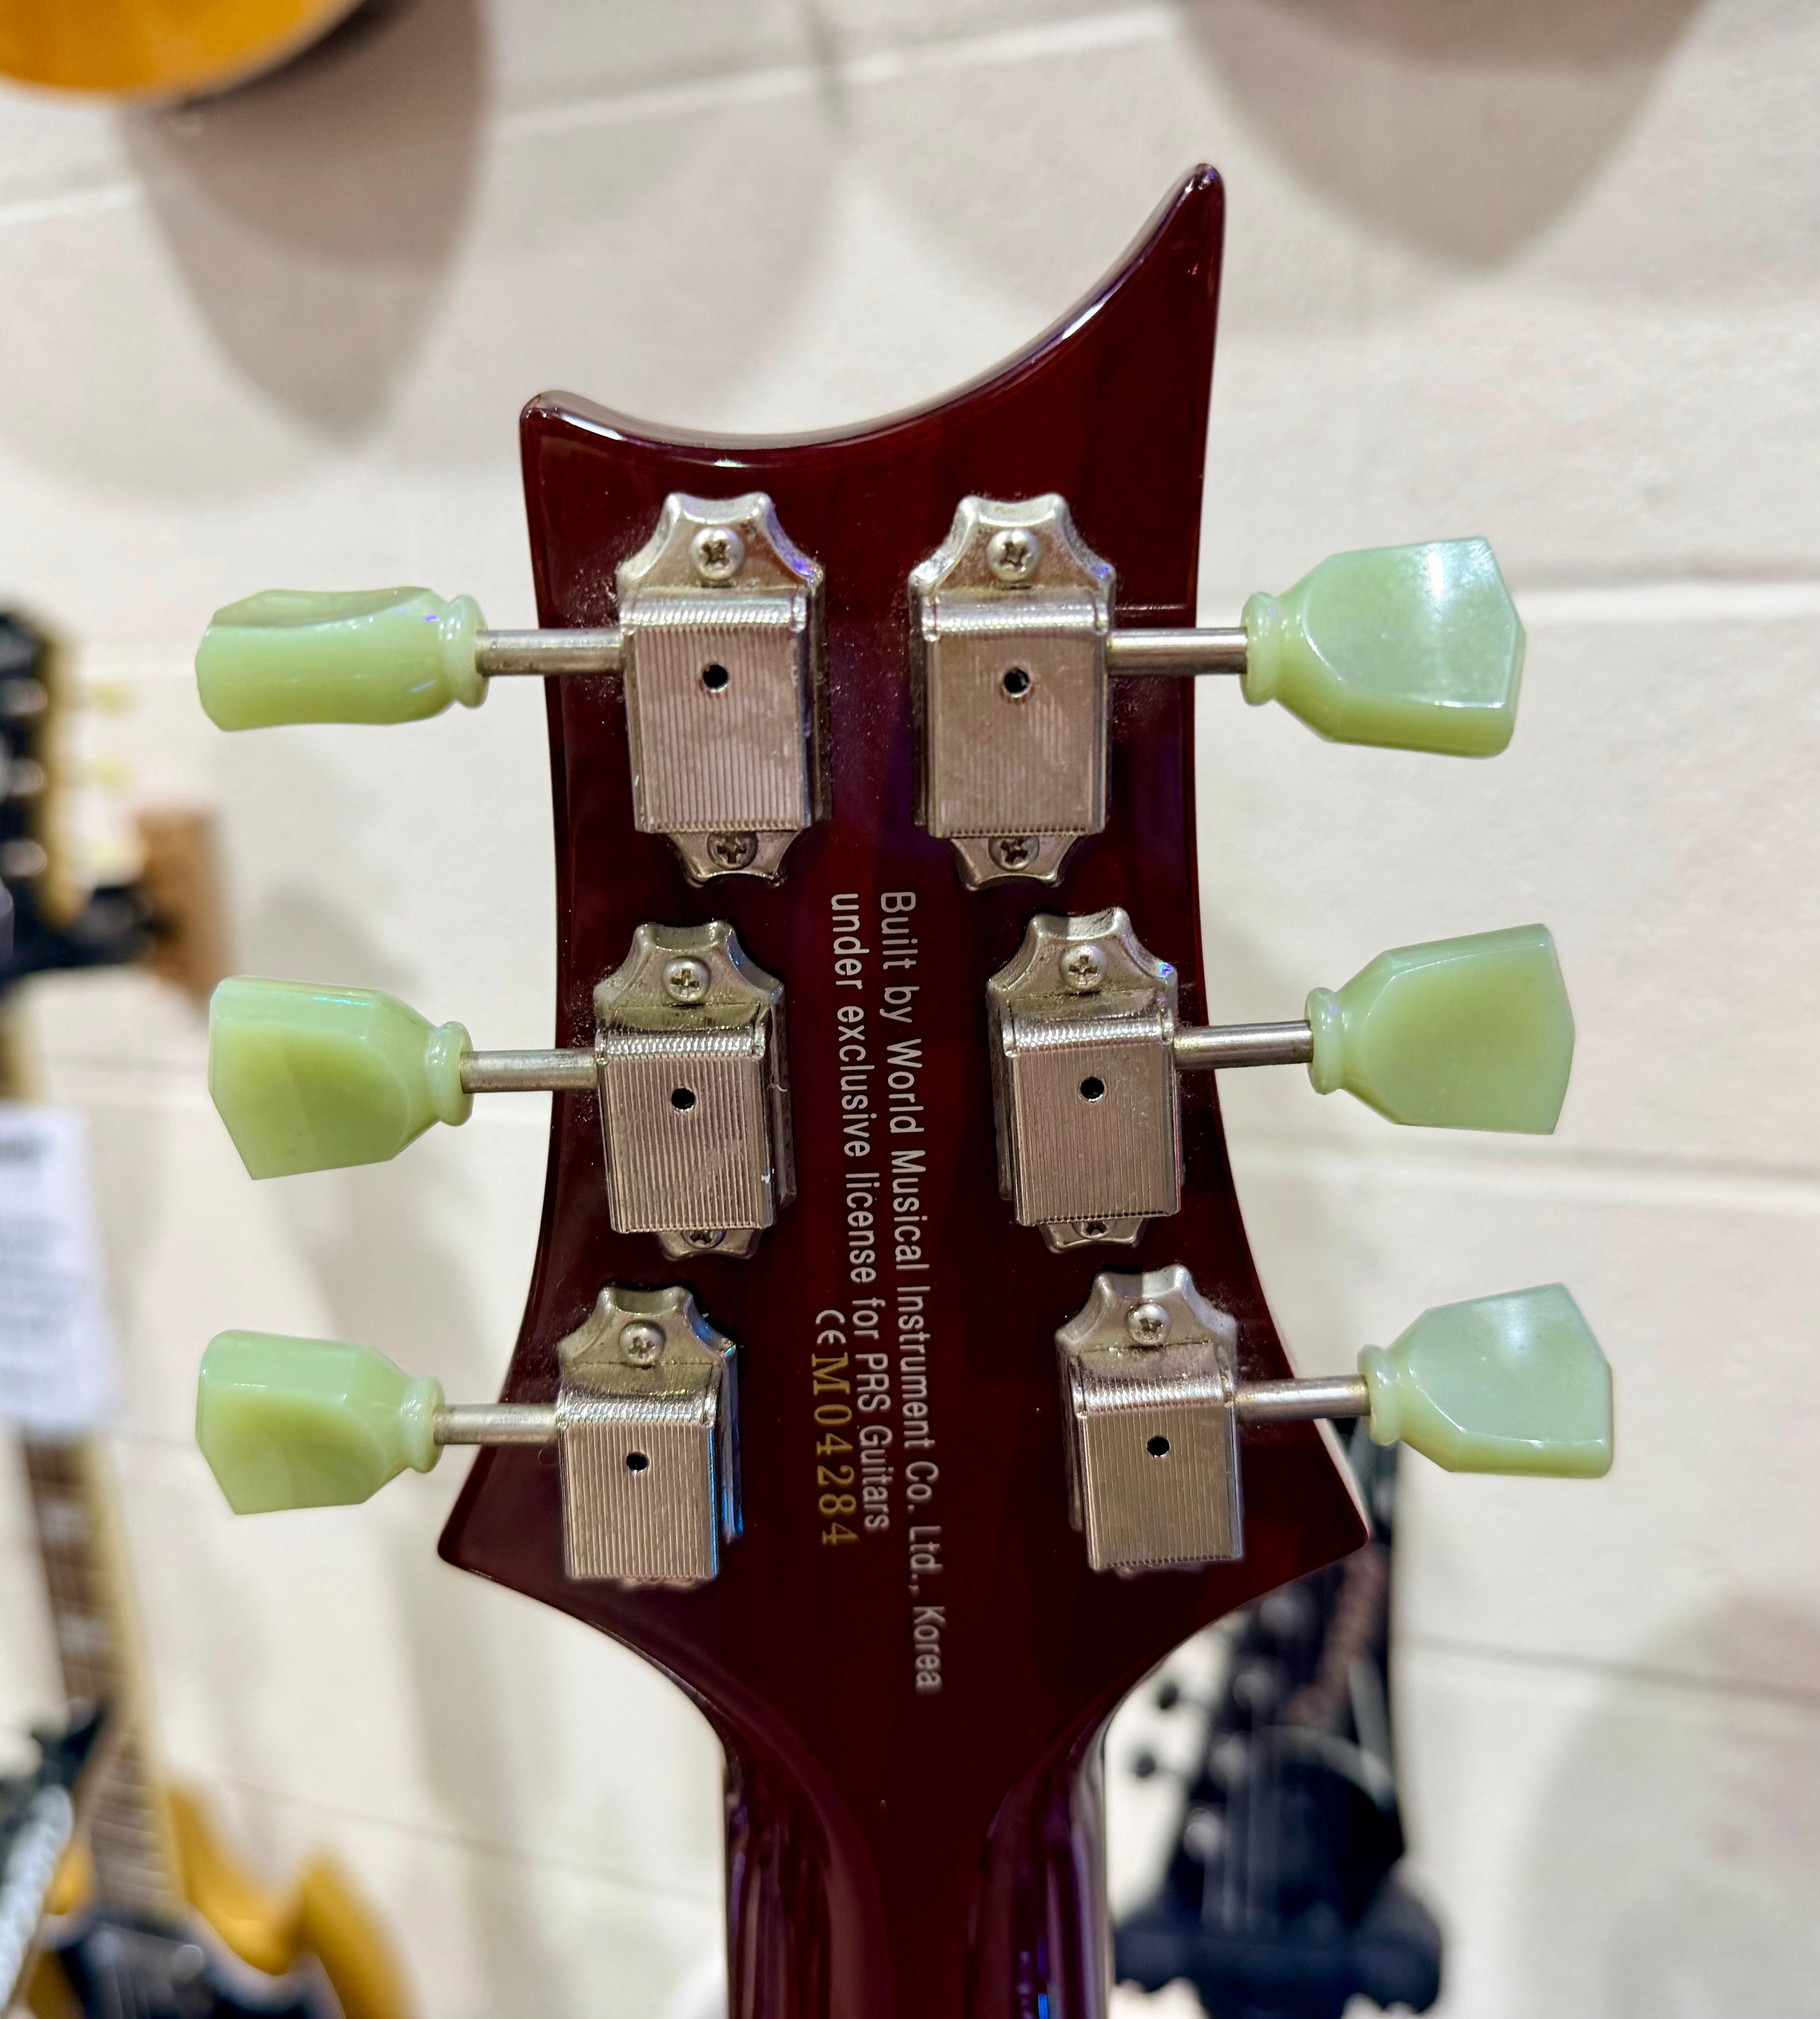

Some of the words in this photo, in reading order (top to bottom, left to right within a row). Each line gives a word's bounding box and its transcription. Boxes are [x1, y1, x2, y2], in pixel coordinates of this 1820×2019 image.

[831, 894, 869, 989] under
[881, 892, 918, 969] Built
[879, 986, 919, 1023] by
[837, 1006, 877, 1157] exclusive
[886, 1039, 924, 1133] World
[845, 1172, 880, 1283] license
[891, 1150, 930, 1270] Musical
[852, 1297, 886, 1340] for
[855, 1353, 891, 1413] PRS
[896, 1286, 935, 1450] Instrument
[812, 1352, 860, 1546] M04284
[859, 1425, 894, 1533] Guitars
[905, 1461, 940, 1514] Co.
[909, 1526, 943, 1595] Ltd.,
[912, 1606, 946, 1695] Korea
